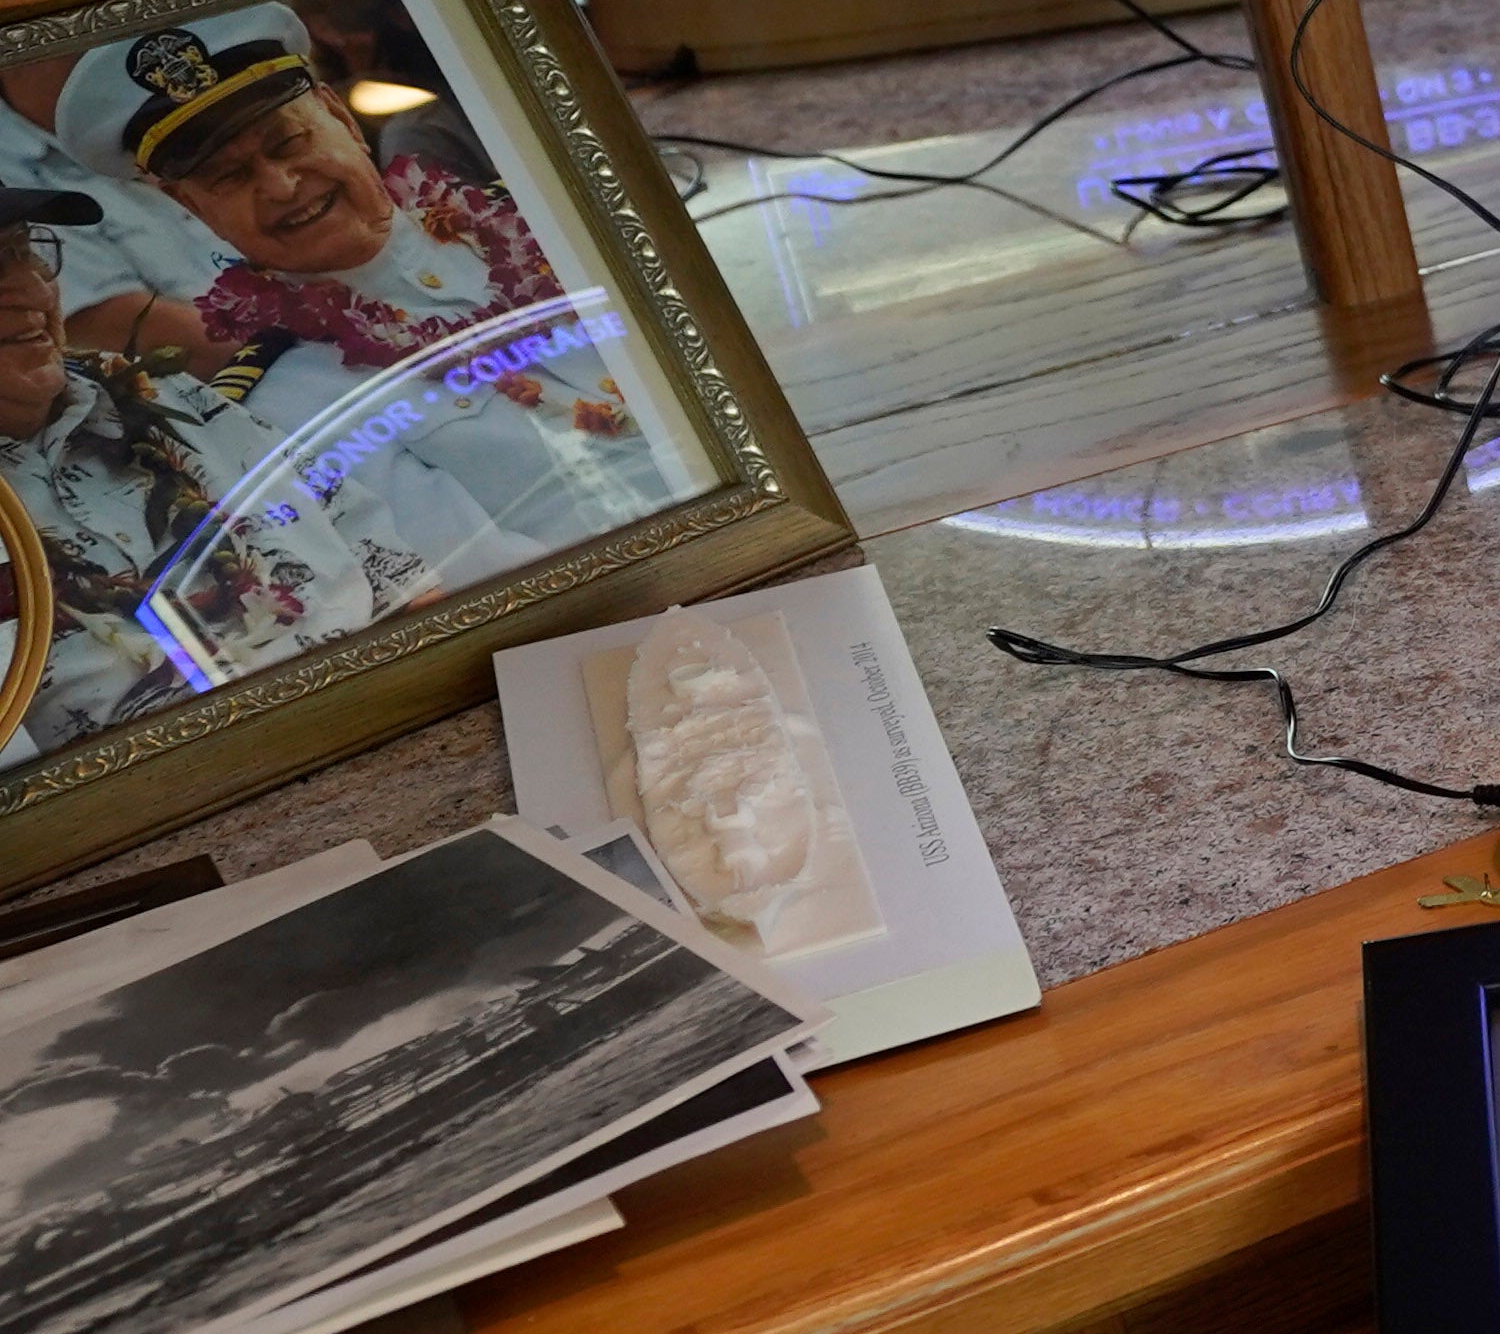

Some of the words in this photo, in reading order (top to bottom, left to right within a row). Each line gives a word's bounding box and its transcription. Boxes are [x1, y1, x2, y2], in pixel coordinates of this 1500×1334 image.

[444, 312, 628, 396] COURAGE
[850, 641, 873, 667] 2014
[860, 665, 891, 703] October
[893, 744, 911, 759] as
[891, 758, 930, 799] (BB39)
[912, 795, 942, 839] Arizona
[919, 838, 950, 868] USS
